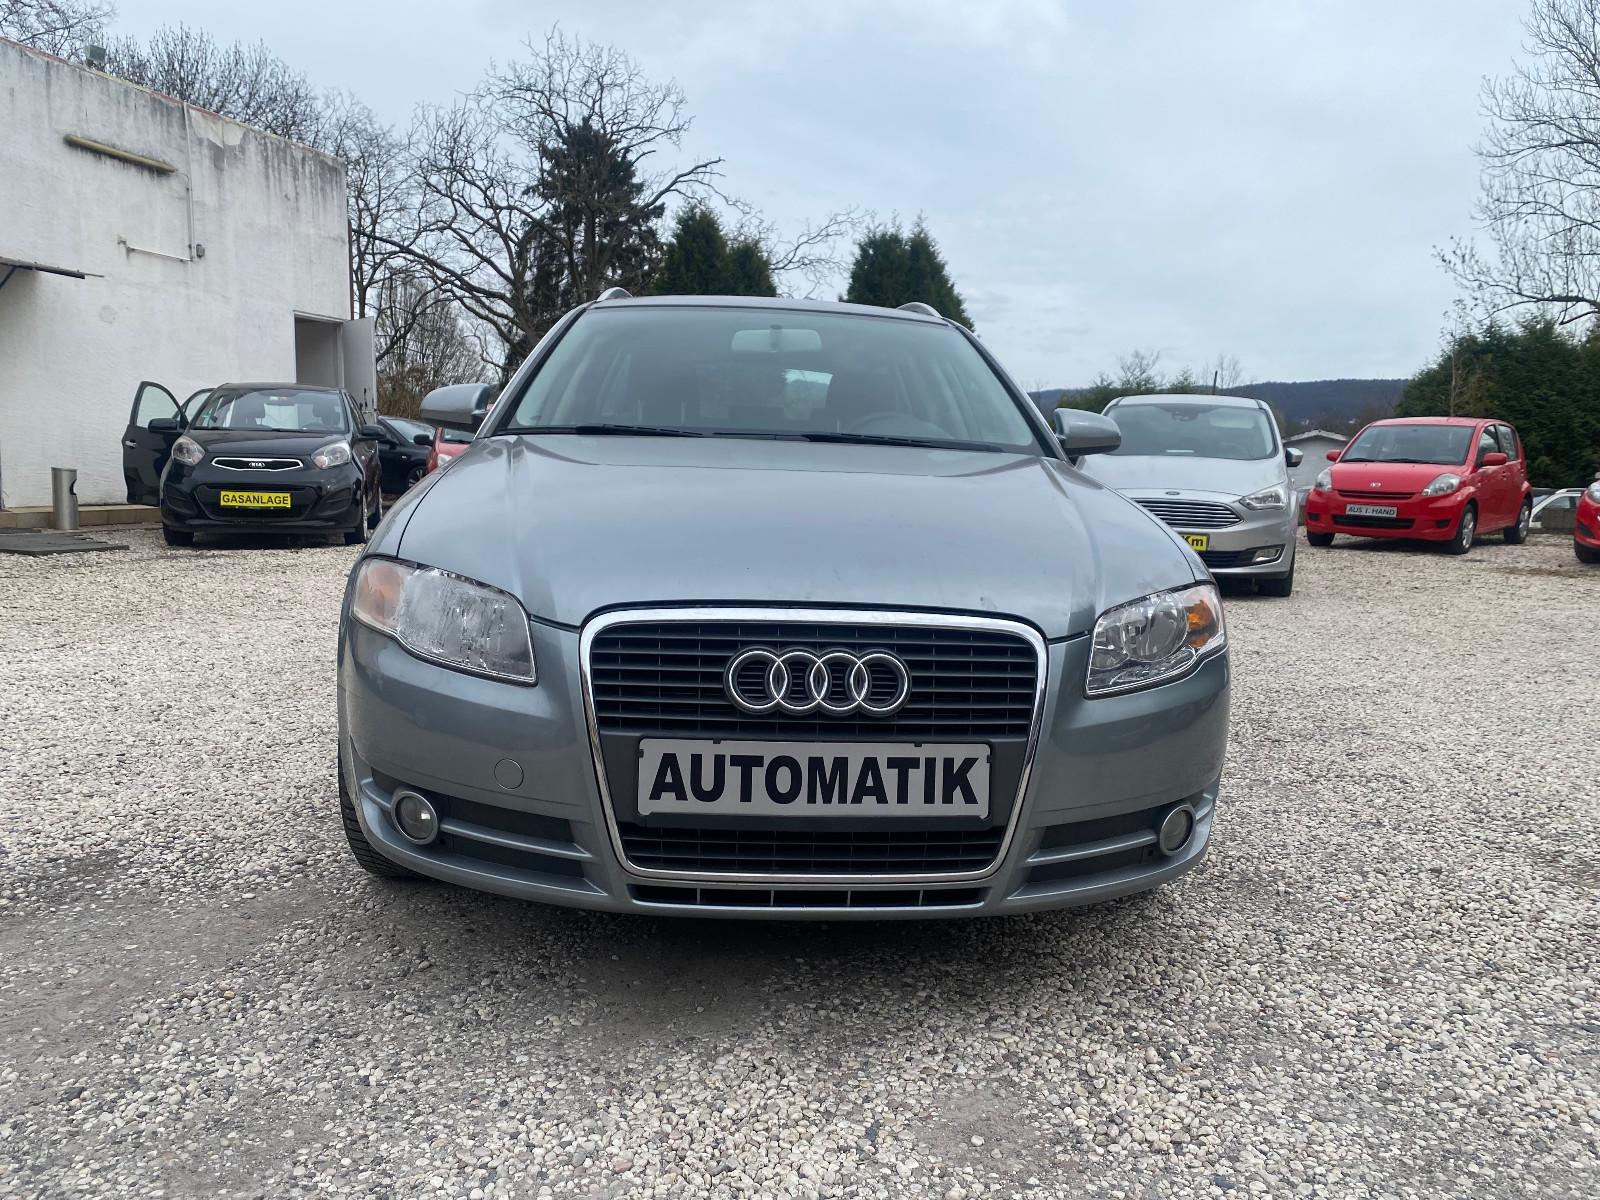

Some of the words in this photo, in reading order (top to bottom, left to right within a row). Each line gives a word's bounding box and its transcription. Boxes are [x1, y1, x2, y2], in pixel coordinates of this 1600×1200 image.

[222, 494, 289, 505] GASANLAGE
[1372, 508, 1395, 516] HAND
[649, 752, 979, 805] AUTOMATIK
